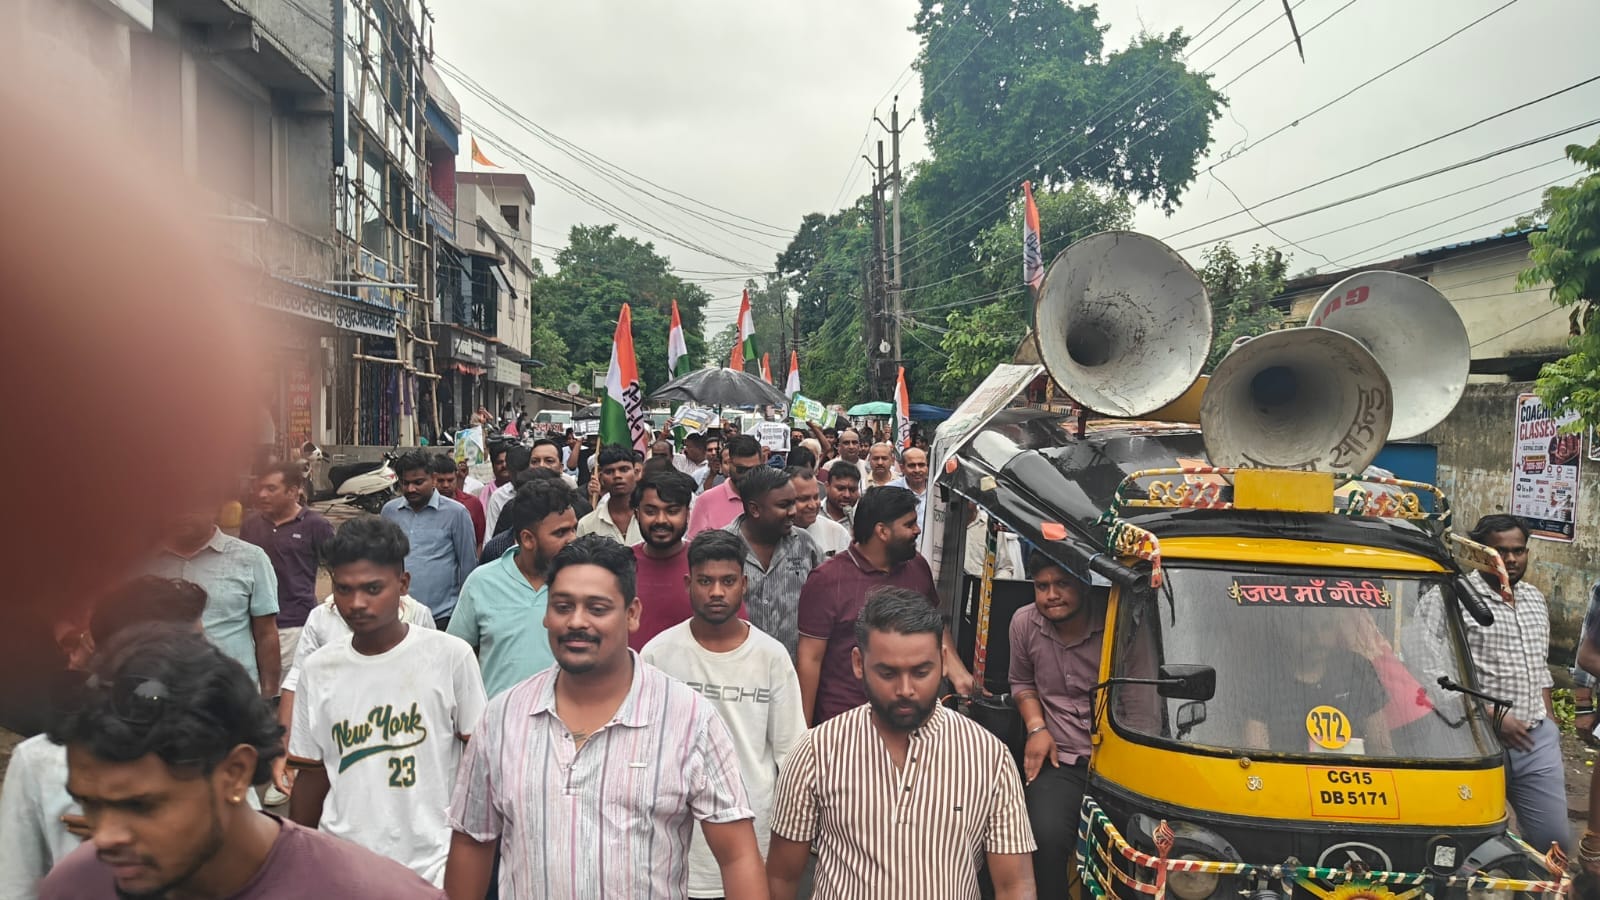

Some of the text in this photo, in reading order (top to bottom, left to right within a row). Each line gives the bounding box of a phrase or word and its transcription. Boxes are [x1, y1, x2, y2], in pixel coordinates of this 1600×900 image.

[1519, 419, 1556, 441] CLASSES
[1240, 584, 1291, 603] जय
[1291, 578, 1327, 604] माँ
[1327, 580, 1387, 607] गौरी
[331, 701, 427, 755] New York
[1310, 711, 1346, 742] 372
[388, 755, 417, 788] 23
[1327, 769, 1373, 785] CG15
[1320, 790, 1388, 806] DB 5171
